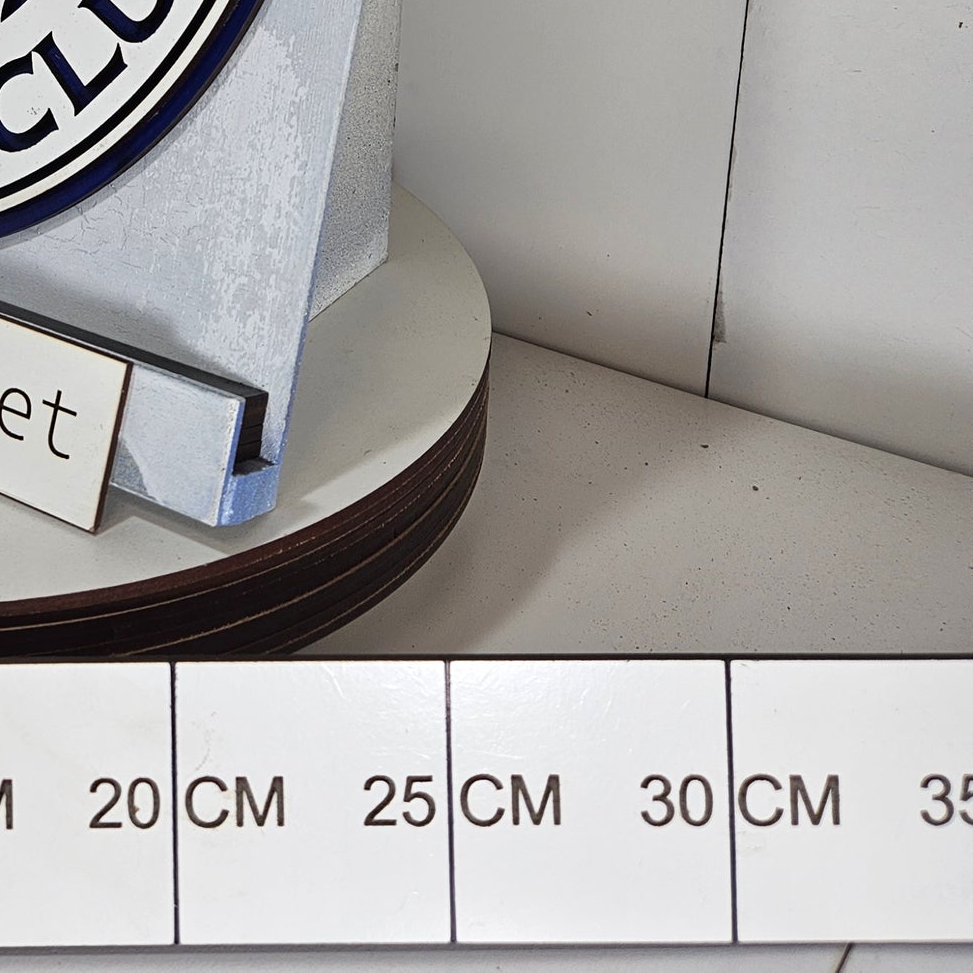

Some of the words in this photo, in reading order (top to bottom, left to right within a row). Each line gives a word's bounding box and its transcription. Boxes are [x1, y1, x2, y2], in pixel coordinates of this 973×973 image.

[89, 777, 161, 829] 20
[185, 775, 286, 827] CM
[361, 774, 438, 827] 25
[460, 773, 562, 827] CM
[639, 774, 713, 827] 30
[738, 774, 842, 827] CM
